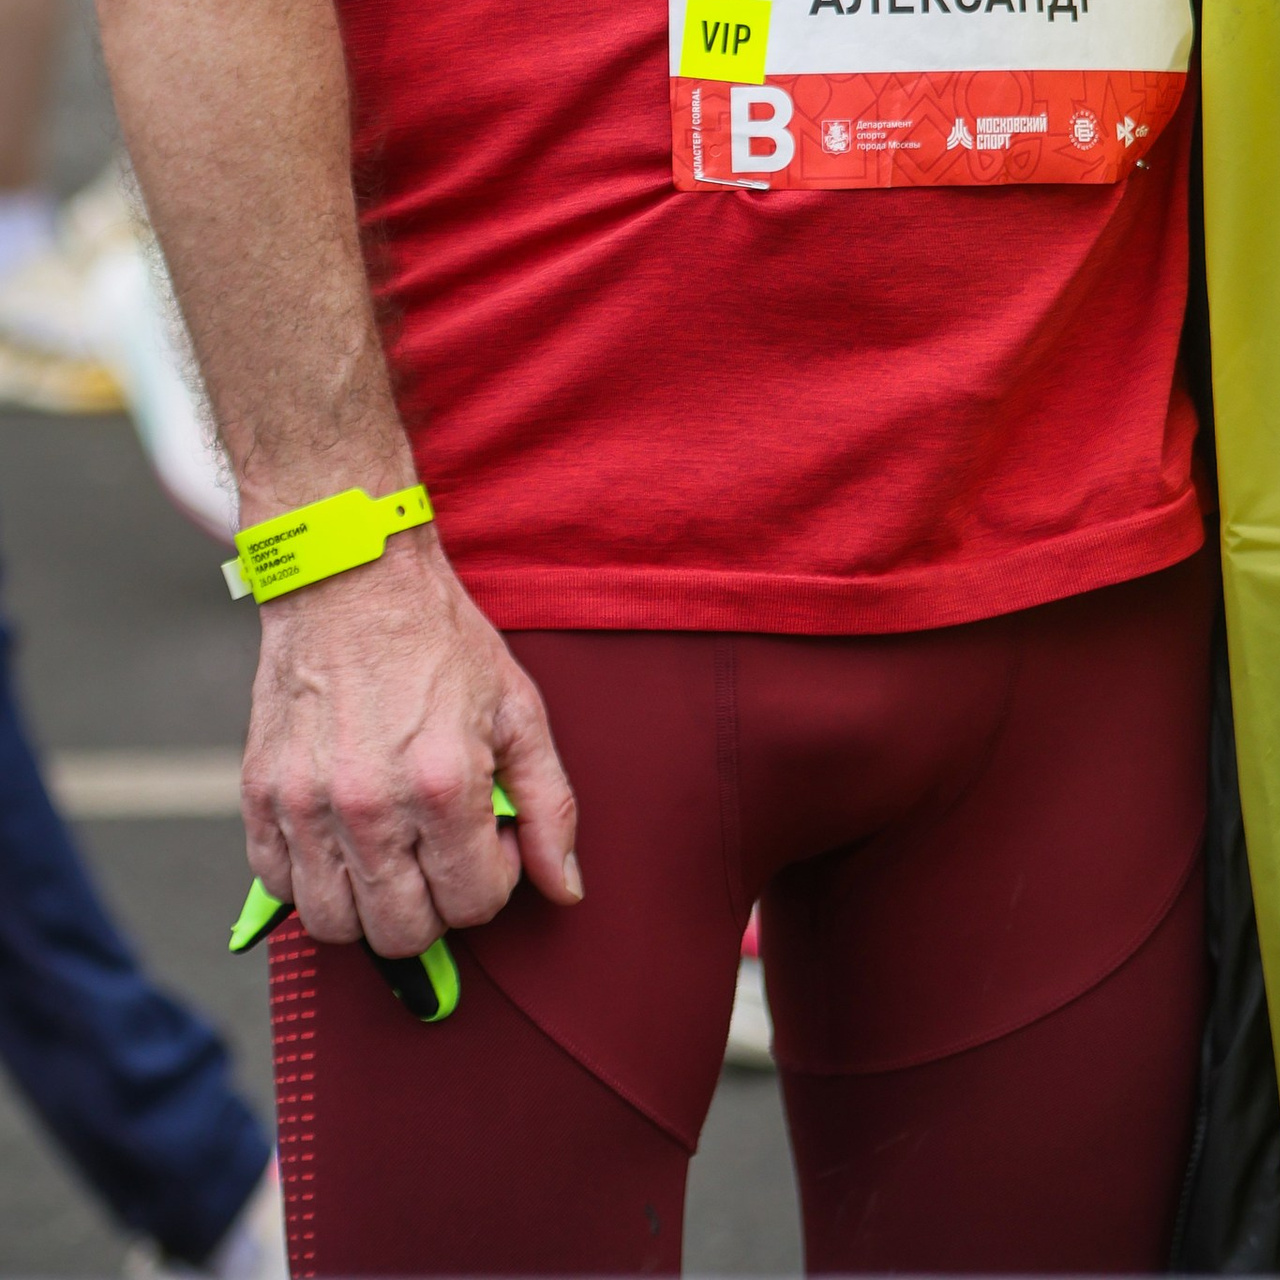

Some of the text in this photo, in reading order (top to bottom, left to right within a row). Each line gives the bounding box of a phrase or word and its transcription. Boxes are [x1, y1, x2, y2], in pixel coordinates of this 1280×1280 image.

[701, 20, 751, 56] VIP
[856, 120, 912, 130] Департамент
[977, 114, 1047, 132] МОСКОВСКИЙ
[857, 132, 886, 141] спорта
[976, 134, 1012, 150] СПОРТ
[857, 141, 921, 151] города Москвы
